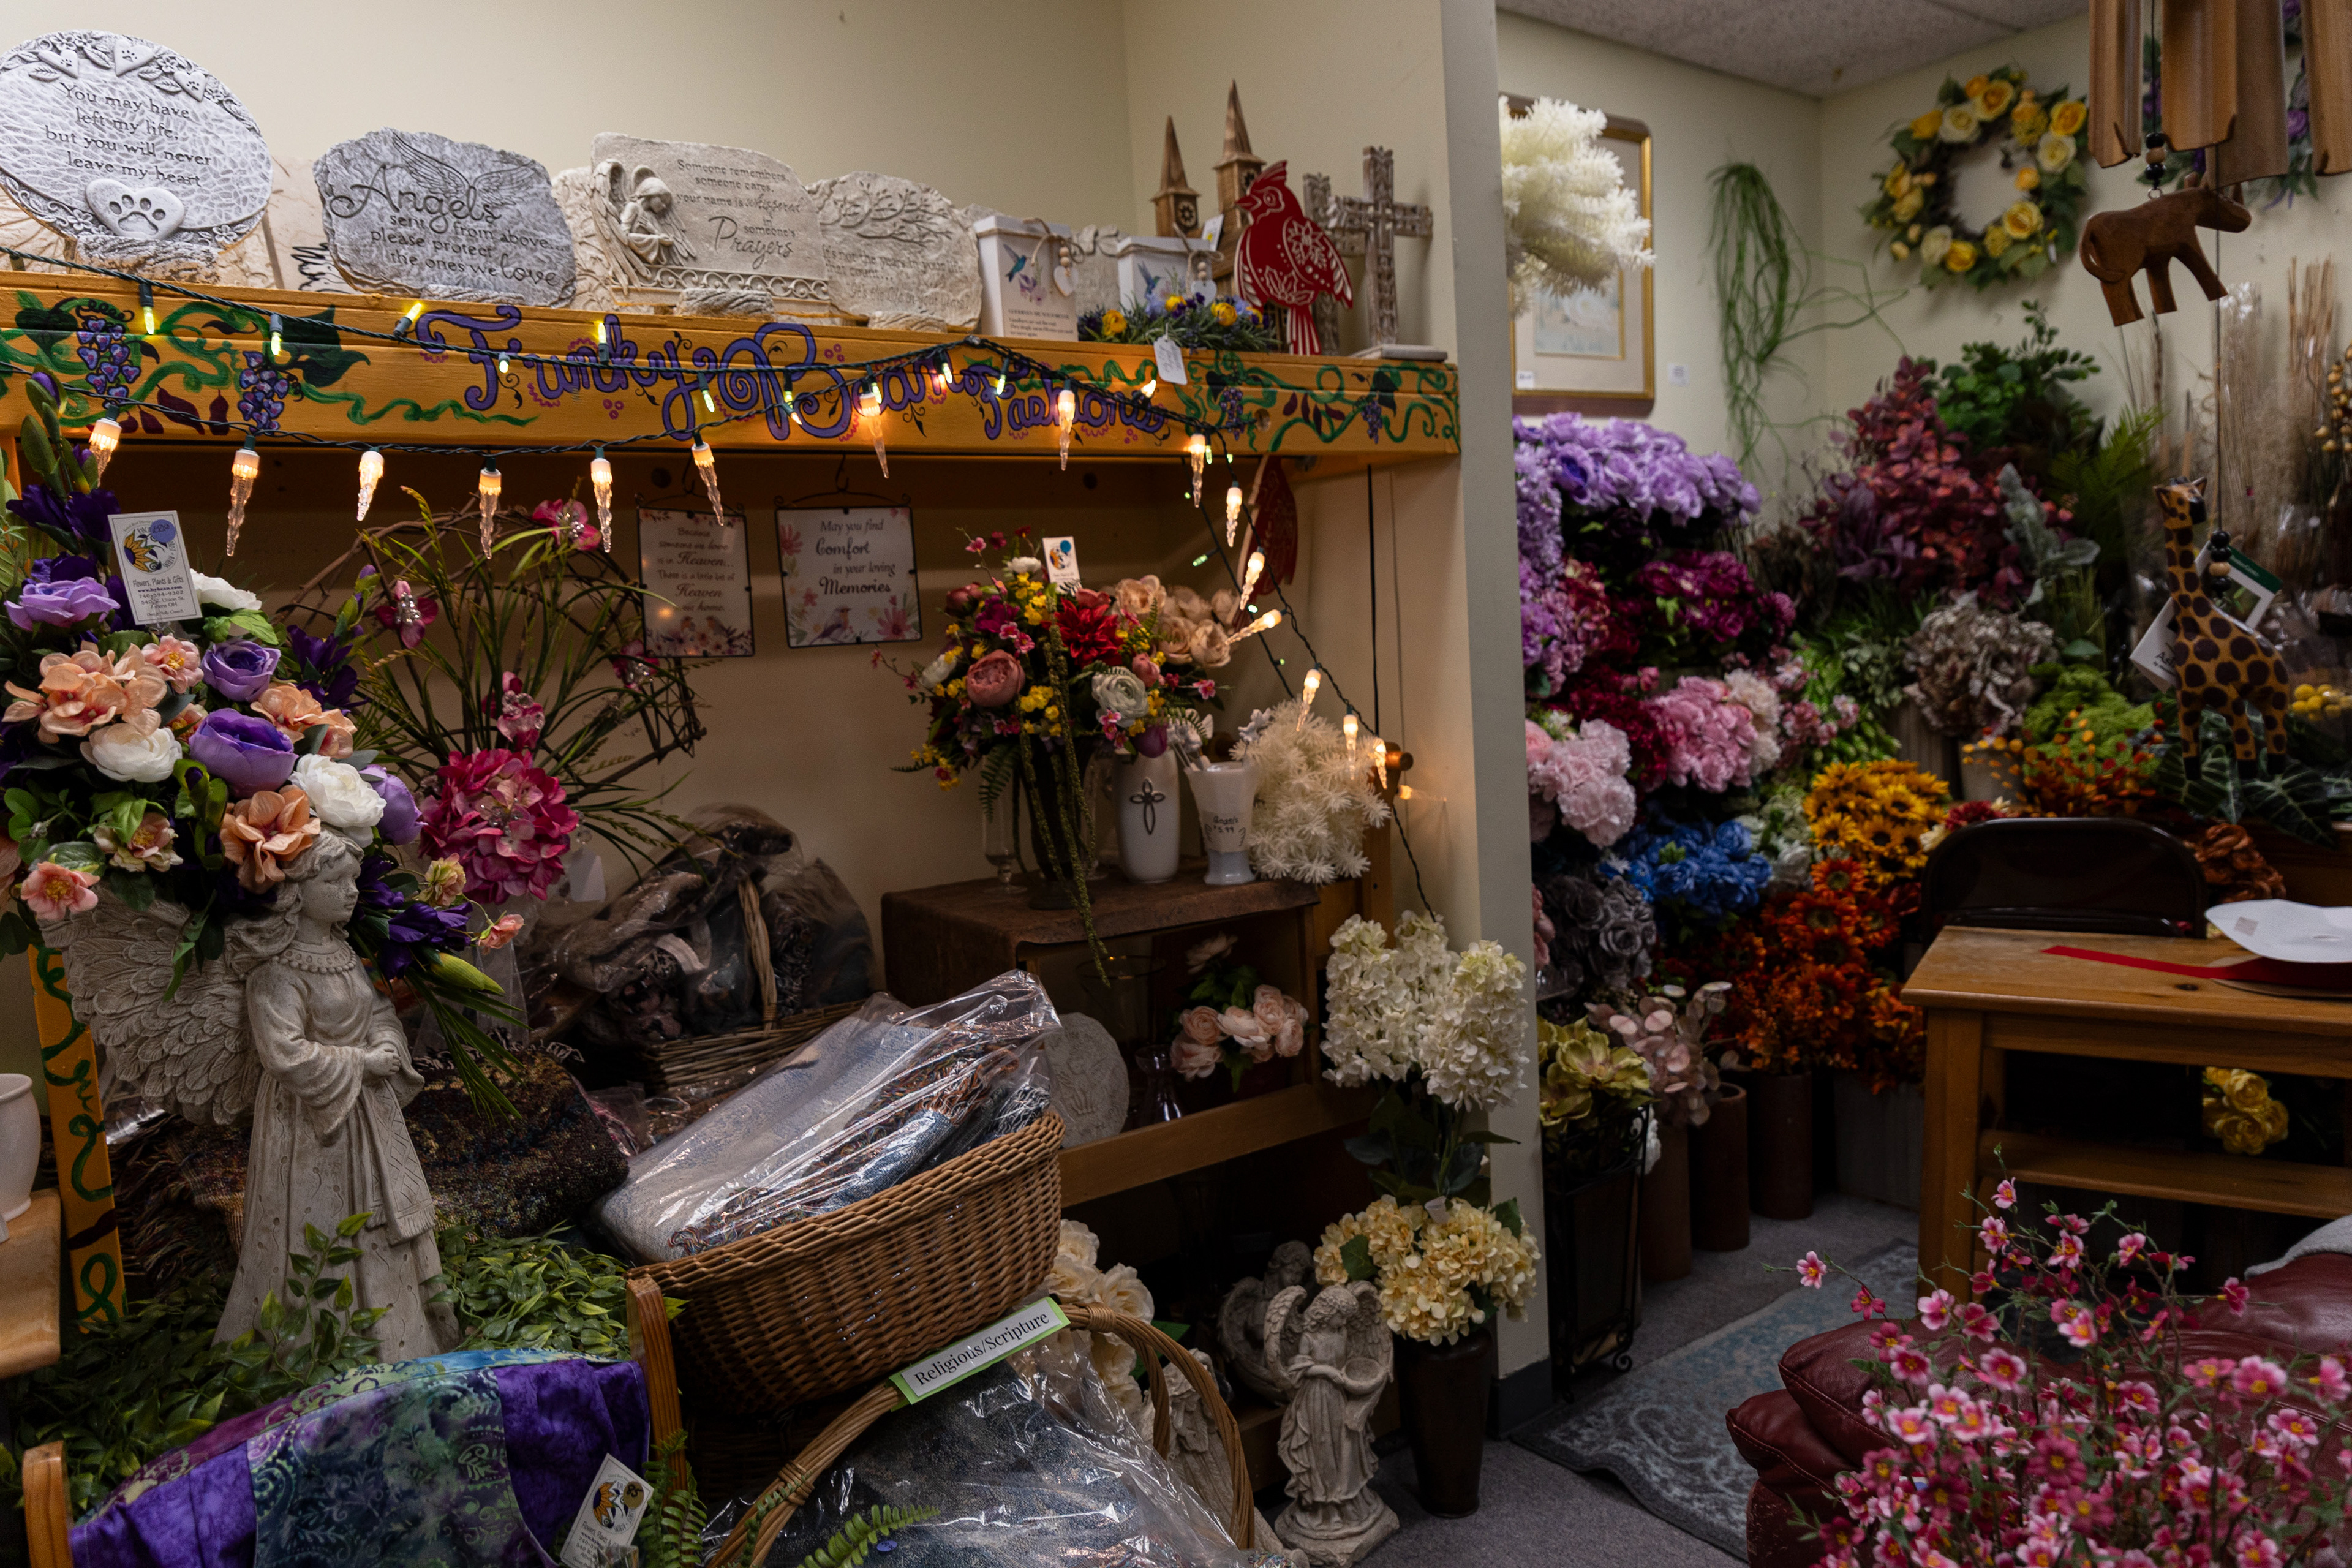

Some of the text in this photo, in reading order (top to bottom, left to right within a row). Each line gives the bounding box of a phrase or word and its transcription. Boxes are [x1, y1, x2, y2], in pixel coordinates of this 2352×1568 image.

[59, 82, 190, 119] You may have
[76, 107, 178, 140] left my life,
[45, 125, 212, 165] but you will never
[67, 151, 202, 187] leave my heart
[677, 159, 726, 175] Someone
[695, 176, 741, 189] someone
[329, 163, 502, 234] Angels
[676, 193, 701, 204] your
[704, 196, 732, 206] name
[745, 193, 804, 219] whispered
[390, 214, 426, 228] sent
[453, 221, 494, 241] from
[744, 225, 796, 238] someone's
[370, 229, 493, 257] please protect
[708, 215, 793, 270] Prayers
[390, 252, 562, 287] the ones we love
[820, 518, 884, 536] May you find
[816, 536, 870, 560] Comfort
[833, 560, 896, 578] in your loving
[818, 576, 891, 595] Memories
[913, 1313, 1050, 1385] Religious/Scripture
